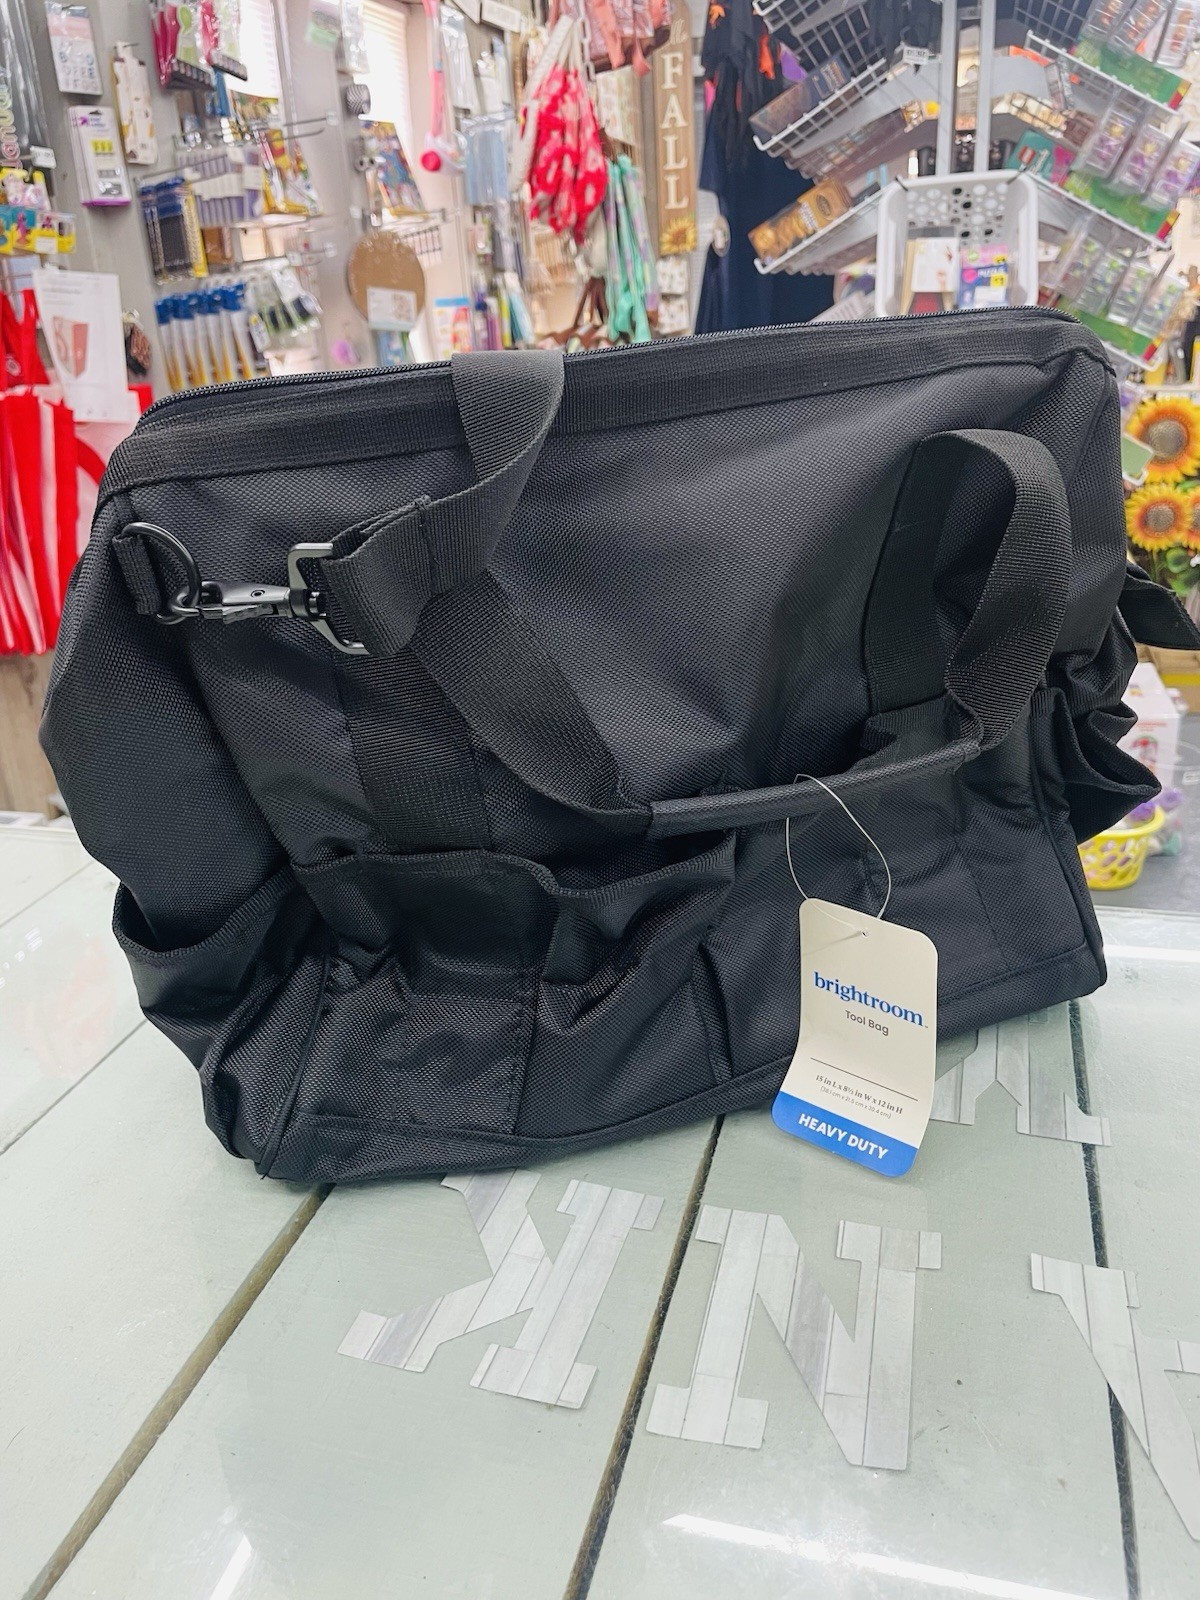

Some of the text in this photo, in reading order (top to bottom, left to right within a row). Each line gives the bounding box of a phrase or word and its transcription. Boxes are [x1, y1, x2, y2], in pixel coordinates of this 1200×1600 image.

[660, 53, 689, 210] FALL
[813, 971, 925, 1028] brightroom
[845, 1009, 889, 1037] Tool Bag
[824, 1077, 832, 1086] in
[854, 1089, 863, 1099] in
[864, 1093, 872, 1101] W
[878, 1099, 886, 1108] 12
[886, 1102, 895, 1111] in
[895, 1106, 903, 1114] H
[798, 1113, 889, 1160] HEAVY DUTY
